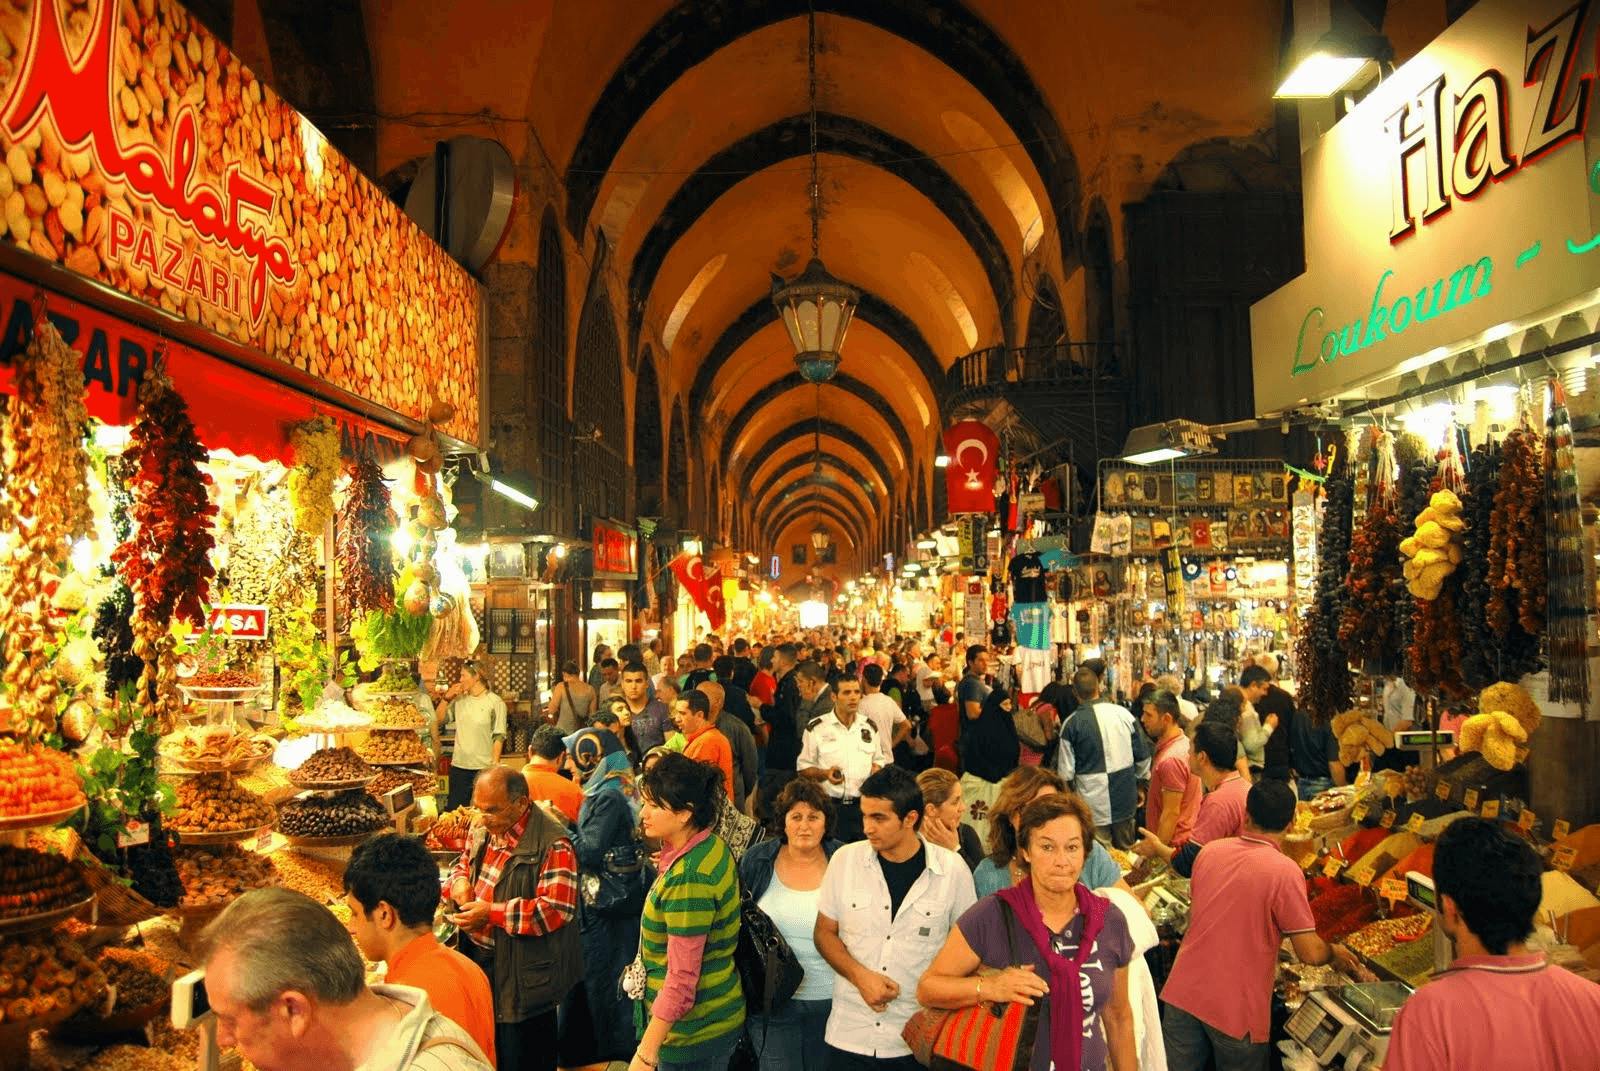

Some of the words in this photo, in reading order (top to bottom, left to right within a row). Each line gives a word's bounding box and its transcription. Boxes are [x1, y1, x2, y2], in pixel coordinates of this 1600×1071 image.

[1384, 0, 1600, 245] Haz
[1292, 256, 1493, 376] Loukoum
[205, 612, 260, 632] ASA
